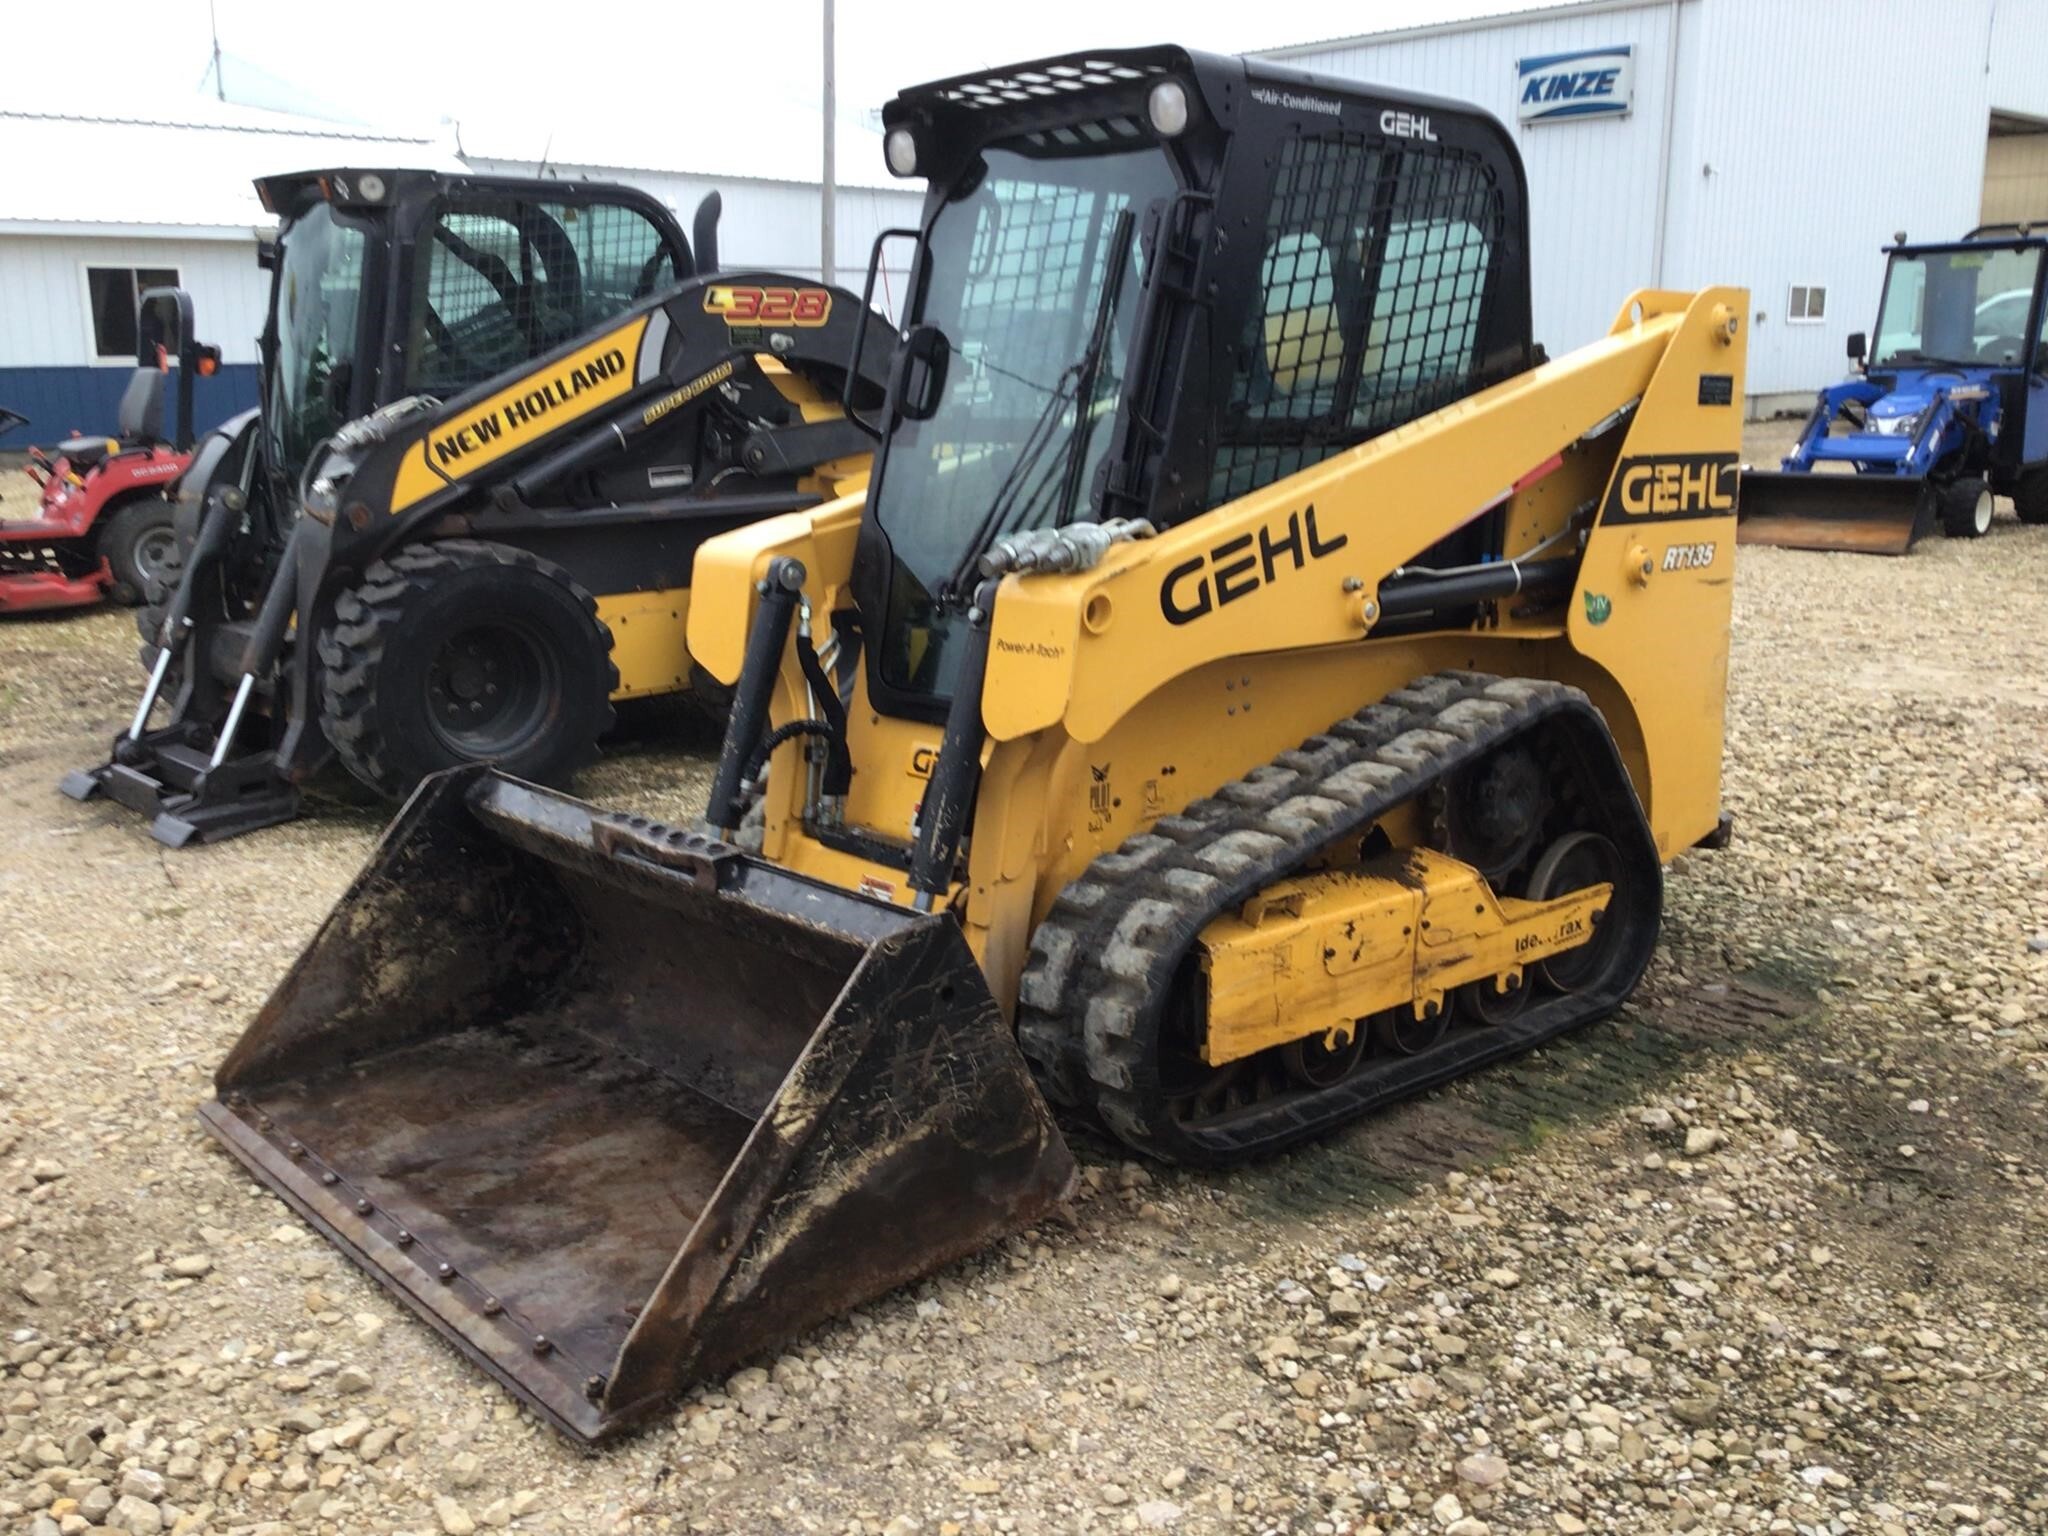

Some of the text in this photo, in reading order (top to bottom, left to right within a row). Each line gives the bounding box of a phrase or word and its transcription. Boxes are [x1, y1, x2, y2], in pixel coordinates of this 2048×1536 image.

[1521, 67, 1621, 104] KINZE
[1380, 110, 1437, 142] GEHL
[703, 285, 832, 327] L328
[434, 348, 625, 465] NEW HOLLAND
[1621, 463, 1732, 515] GEHL
[1160, 503, 1348, 626] GEHL
